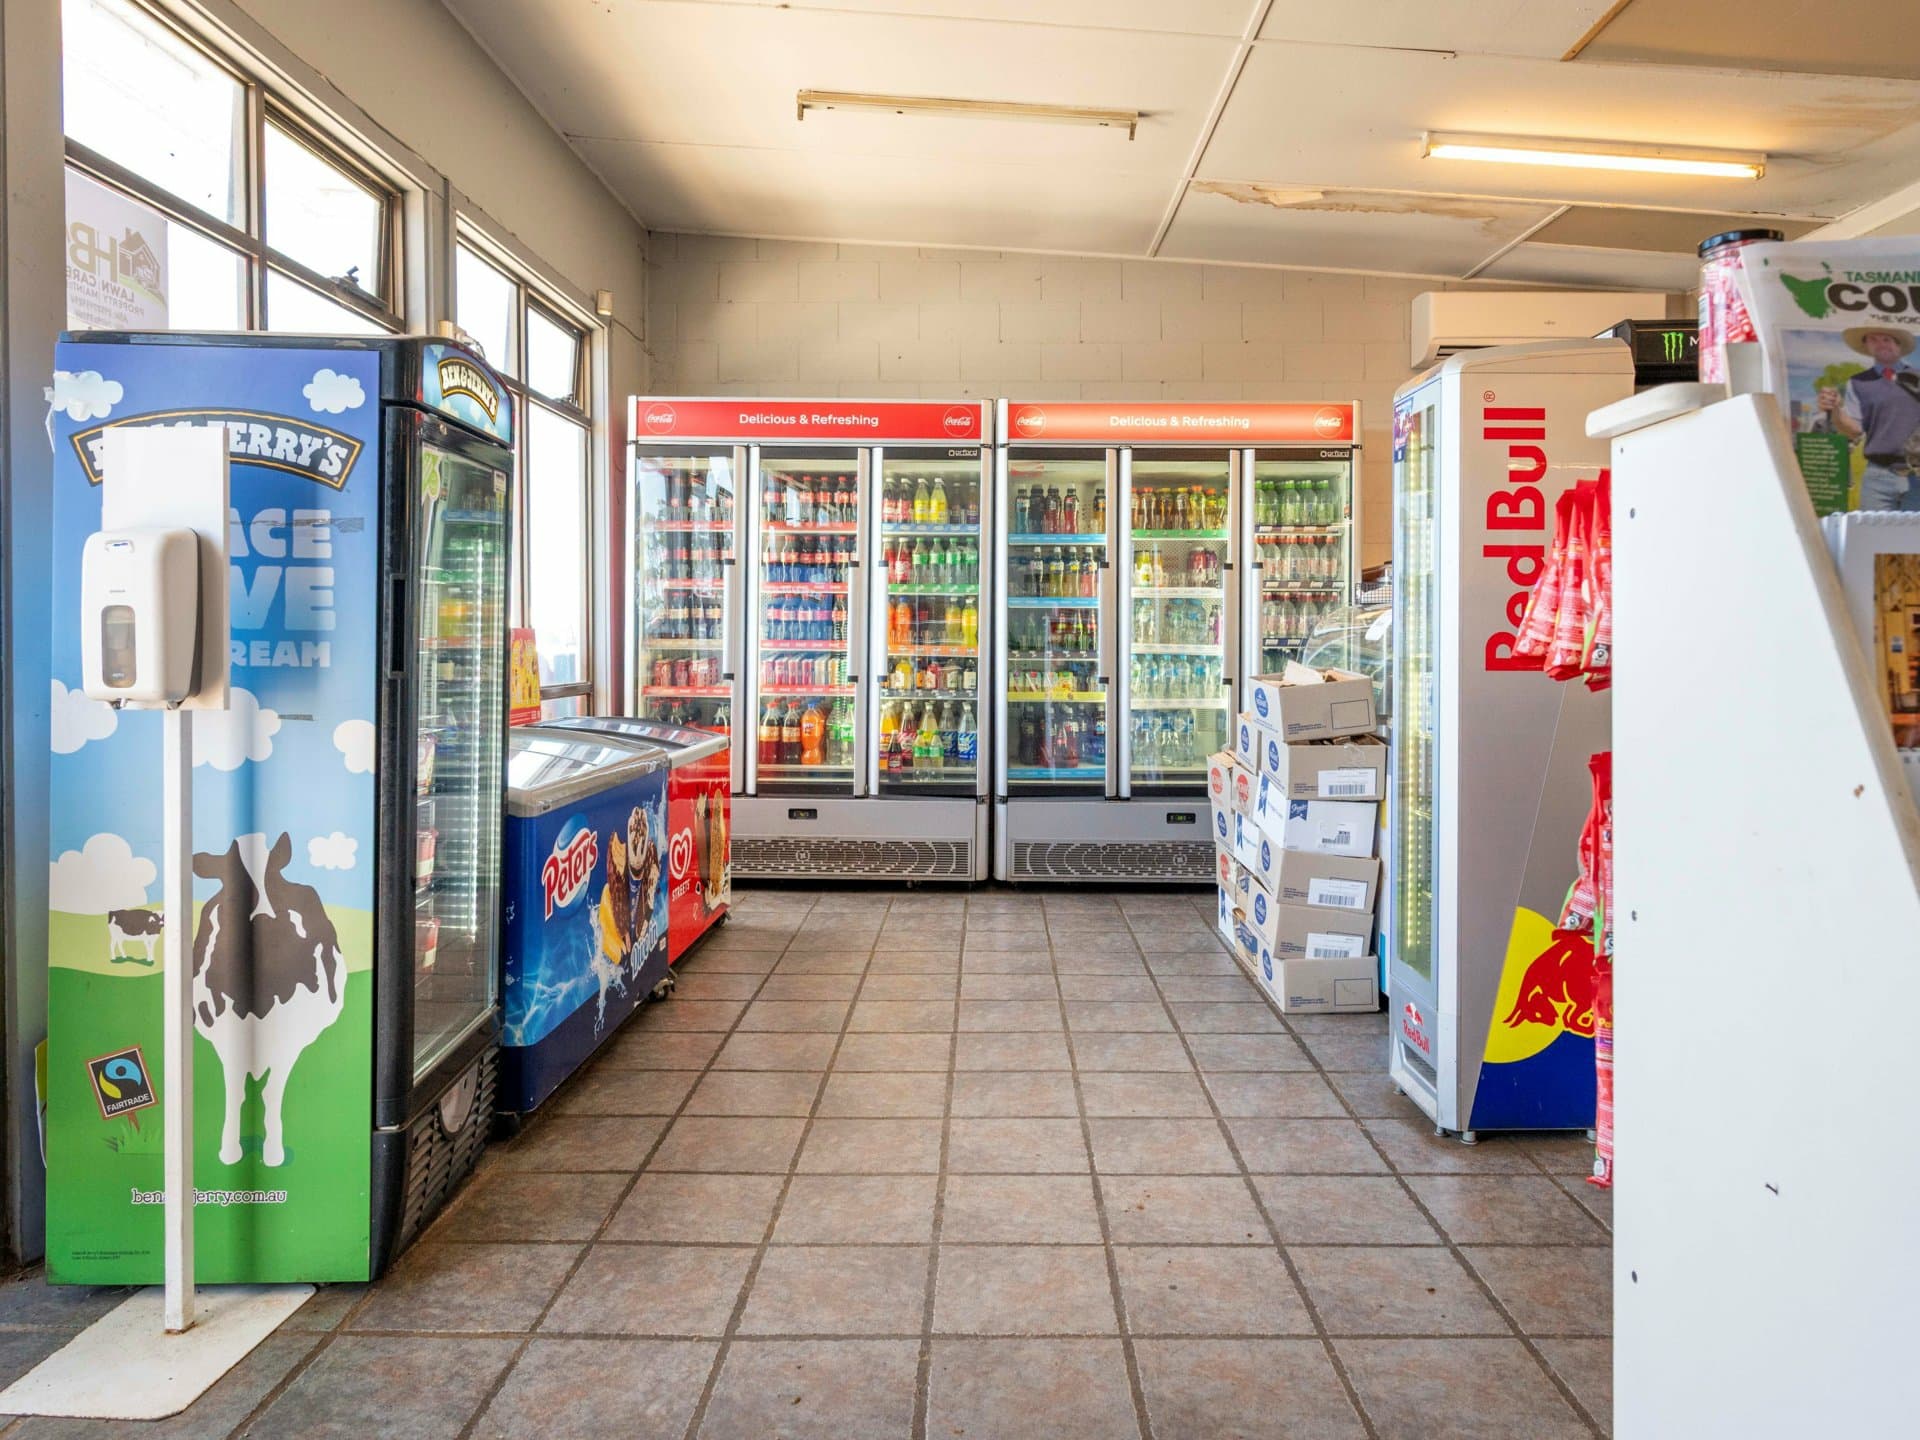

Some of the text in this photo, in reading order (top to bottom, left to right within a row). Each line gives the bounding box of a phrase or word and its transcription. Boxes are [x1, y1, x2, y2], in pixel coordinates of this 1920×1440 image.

[1828, 283, 1920, 314] CO
[739, 413, 879, 427] Delicious & Refreshing
[1110, 415, 1250, 429] Delicious & Refreshing
[1483, 407, 1547, 530] Bull
[229, 566, 336, 630] VE
[229, 641, 331, 668] REAM
[542, 828, 598, 921] Peters
[1402, 1018, 1430, 1056] Red Bull
[106, 1093, 151, 1113] FAIRTRADE
